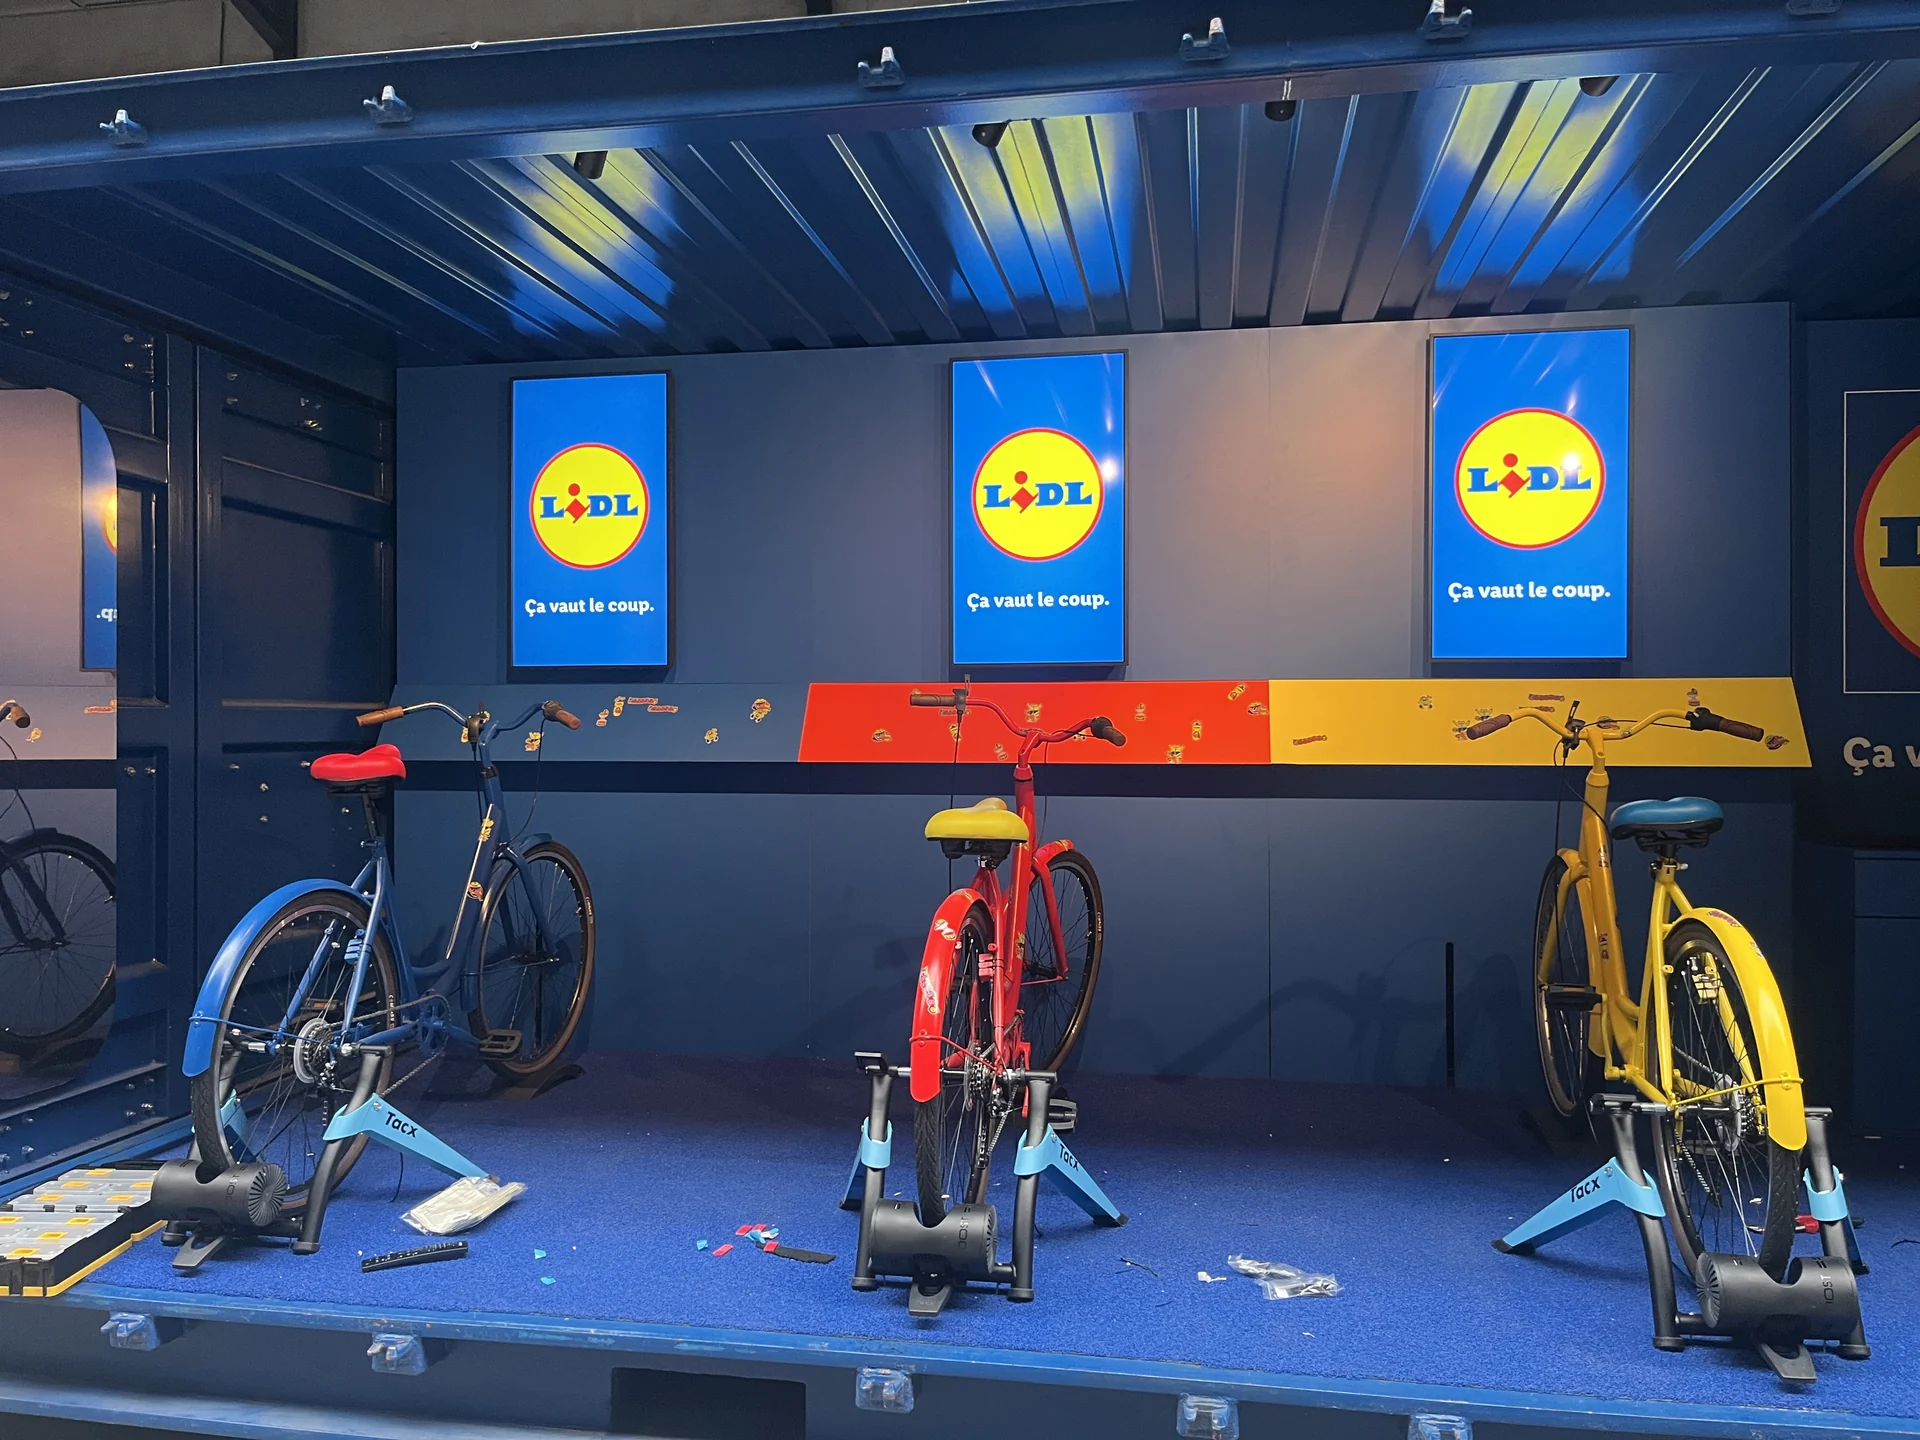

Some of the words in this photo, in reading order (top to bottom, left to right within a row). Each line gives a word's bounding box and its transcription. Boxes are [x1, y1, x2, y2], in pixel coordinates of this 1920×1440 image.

[967, 593, 990, 612] Ça
[993, 593, 1034, 608] vaut
[1037, 591, 1054, 607] le
[1058, 594, 1110, 610] coup.
[1448, 582, 1474, 603] Ça
[1478, 583, 1524, 598] vaut
[1528, 581, 1547, 598] le
[1552, 584, 1611, 601] coup.
[525, 599, 547, 617] Ça
[549, 599, 586, 613] vaut
[589, 597, 604, 612] le
[608, 600, 655, 615] coup.
[1843, 736, 1895, 776] Ça
[385, 1111, 418, 1138] Tacx
[1060, 1143, 1079, 1171] Tacx
[1571, 1176, 1601, 1203] Tacx
